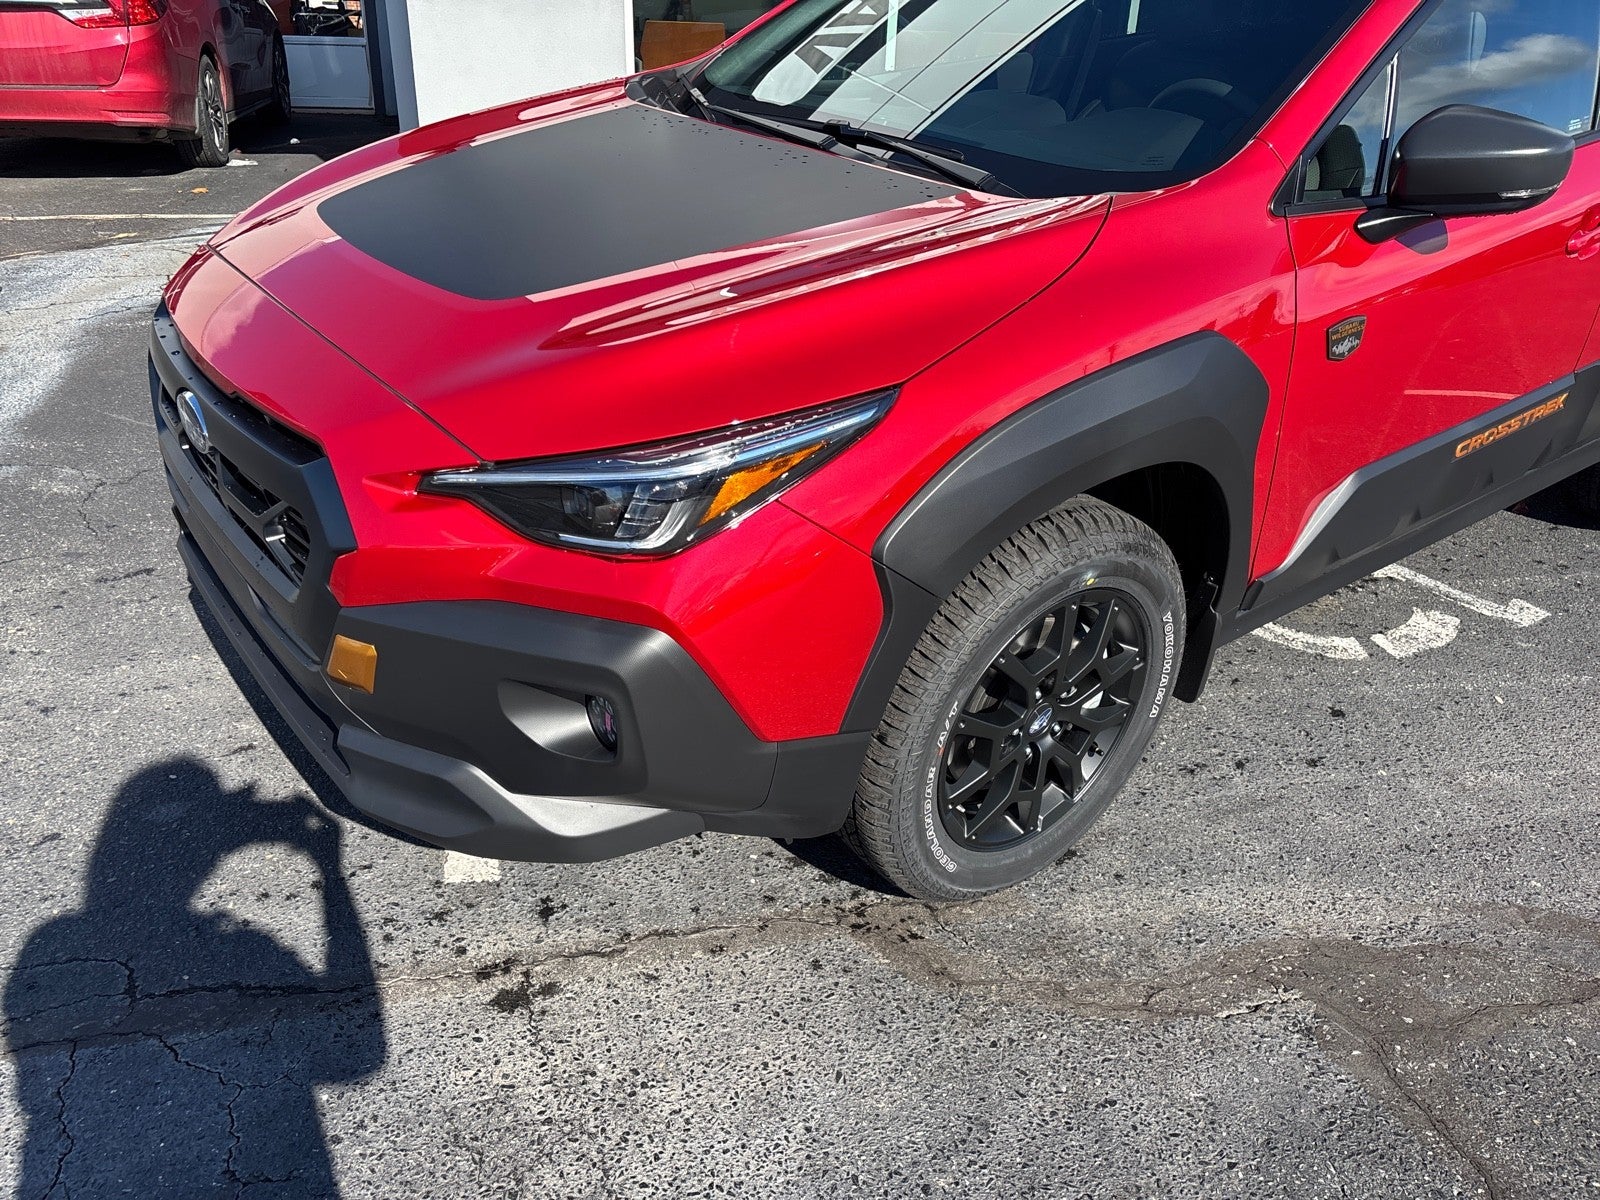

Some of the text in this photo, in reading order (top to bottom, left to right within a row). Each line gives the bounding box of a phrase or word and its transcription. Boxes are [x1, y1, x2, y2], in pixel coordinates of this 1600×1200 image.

[1331, 324, 1364, 340] WILDERNESS
[1338, 321, 1360, 332] SUBARU
[1455, 392, 1569, 458] CROSSTREK
[1149, 610, 1174, 718] YOKOHAMA
[924, 700, 958, 872] GEOLANDAR A/T
